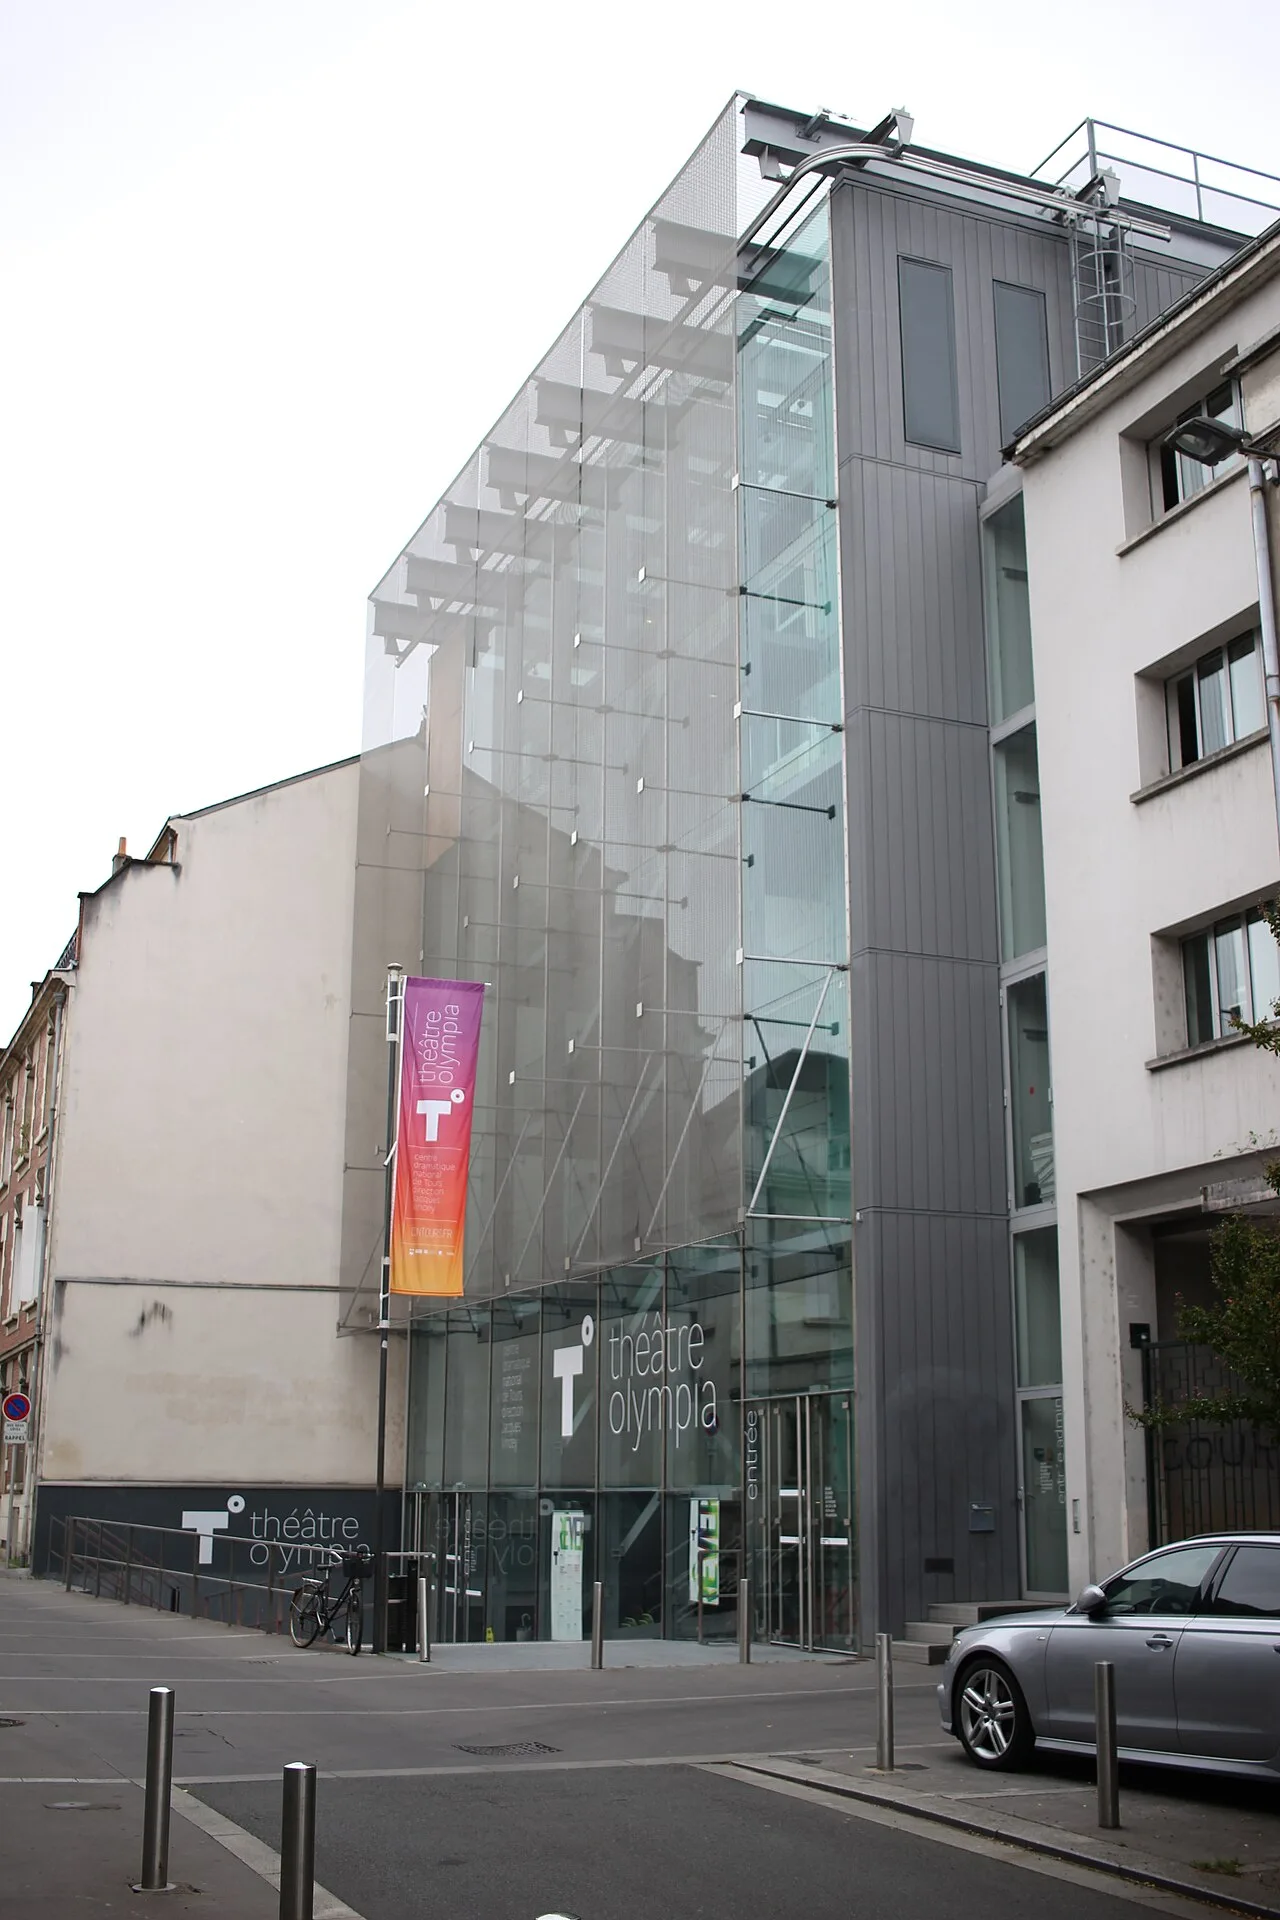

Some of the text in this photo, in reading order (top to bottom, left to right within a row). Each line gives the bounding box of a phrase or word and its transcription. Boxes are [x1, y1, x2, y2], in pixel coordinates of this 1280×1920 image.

[418, 1009, 443, 1083] théâtre
[438, 1003, 461, 1084] olympia
[609, 1311, 705, 1381] théâtre
[609, 1380, 717, 1452] olympia
[744, 1410, 758, 1500] entrée
[250, 1507, 360, 1539] théâtre
